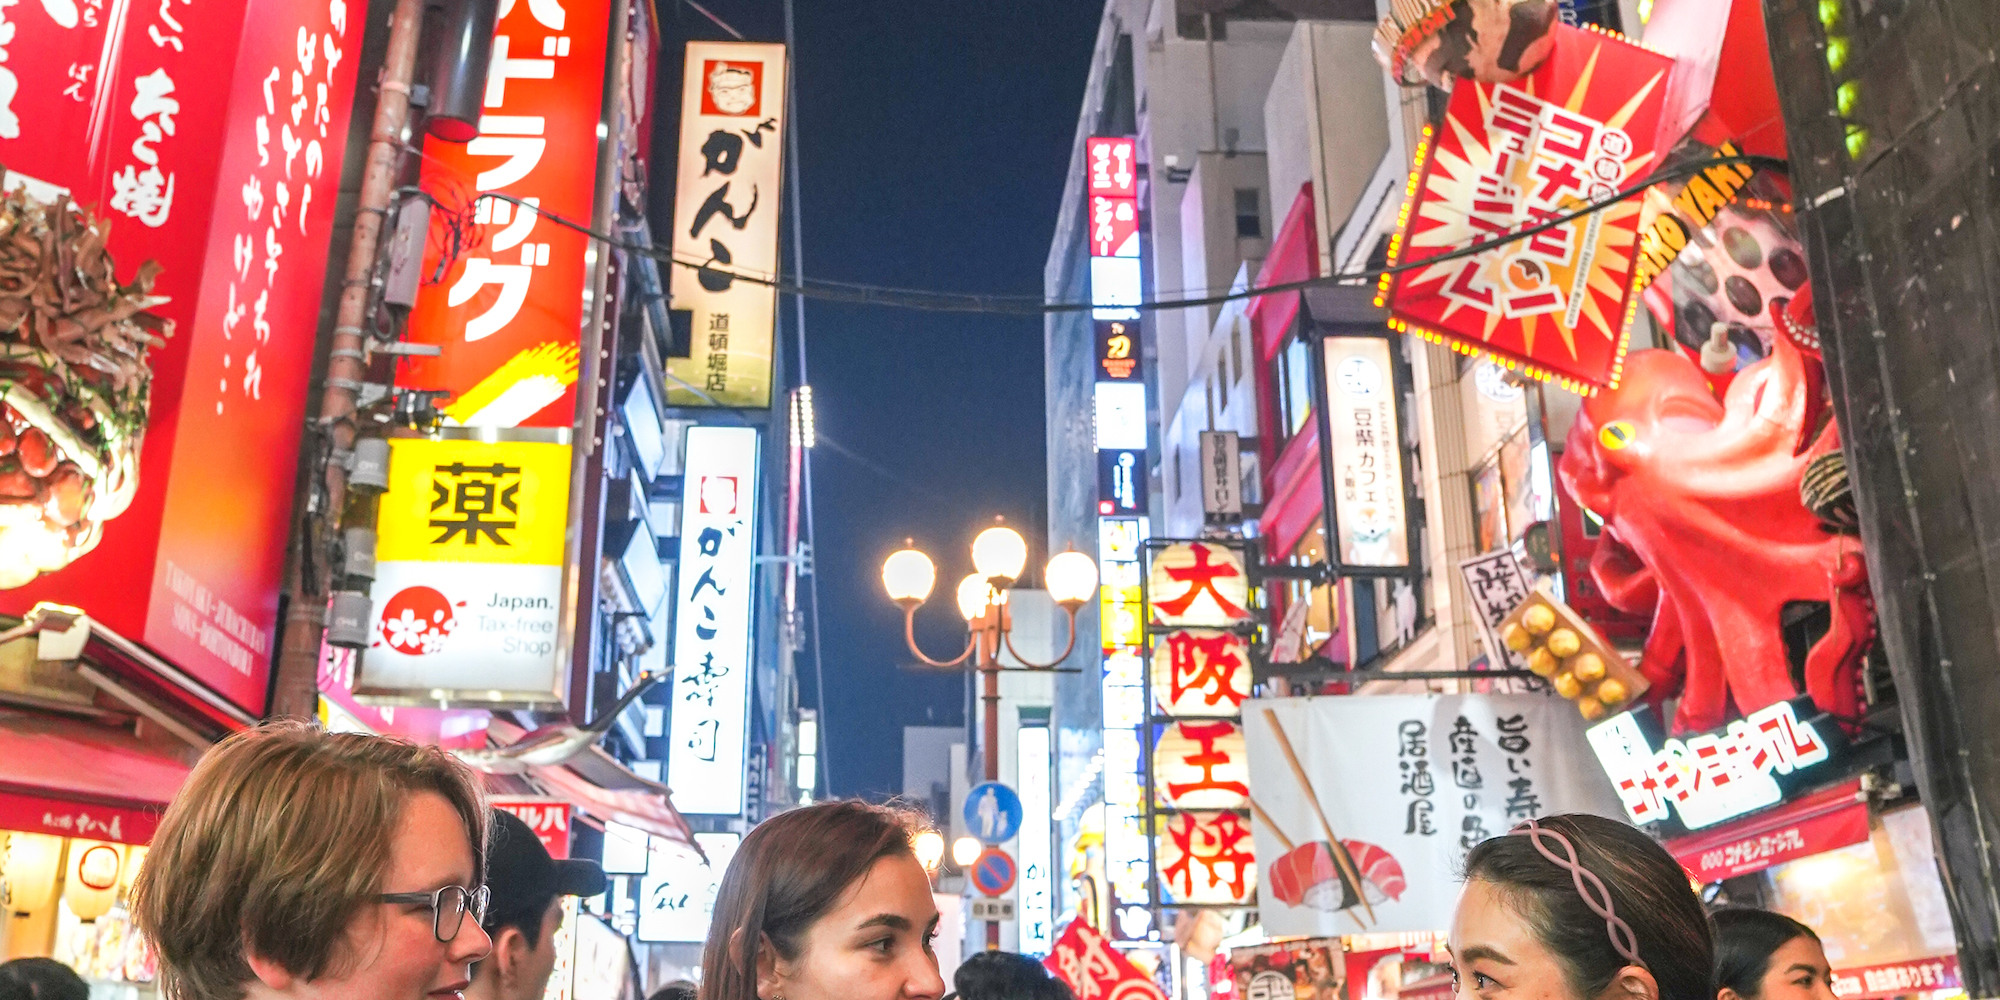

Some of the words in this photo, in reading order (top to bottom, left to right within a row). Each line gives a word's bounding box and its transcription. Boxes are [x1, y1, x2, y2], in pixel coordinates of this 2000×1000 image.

[689, 117, 777, 293] がんこ
[706, 313, 729, 393] 道頓堀店
[1353, 408, 1376, 502] 豆柴カフェ
[429, 461, 522, 546] 薬
[476, 616, 553, 633] Tax-free
[486, 592, 554, 611] Japan.
[503, 638, 552, 658] Shop
[1151, 541, 1256, 899] 大阪王将
[1397, 719, 1438, 837] 居酒屋
[1056, 928, 1121, 998] 射
